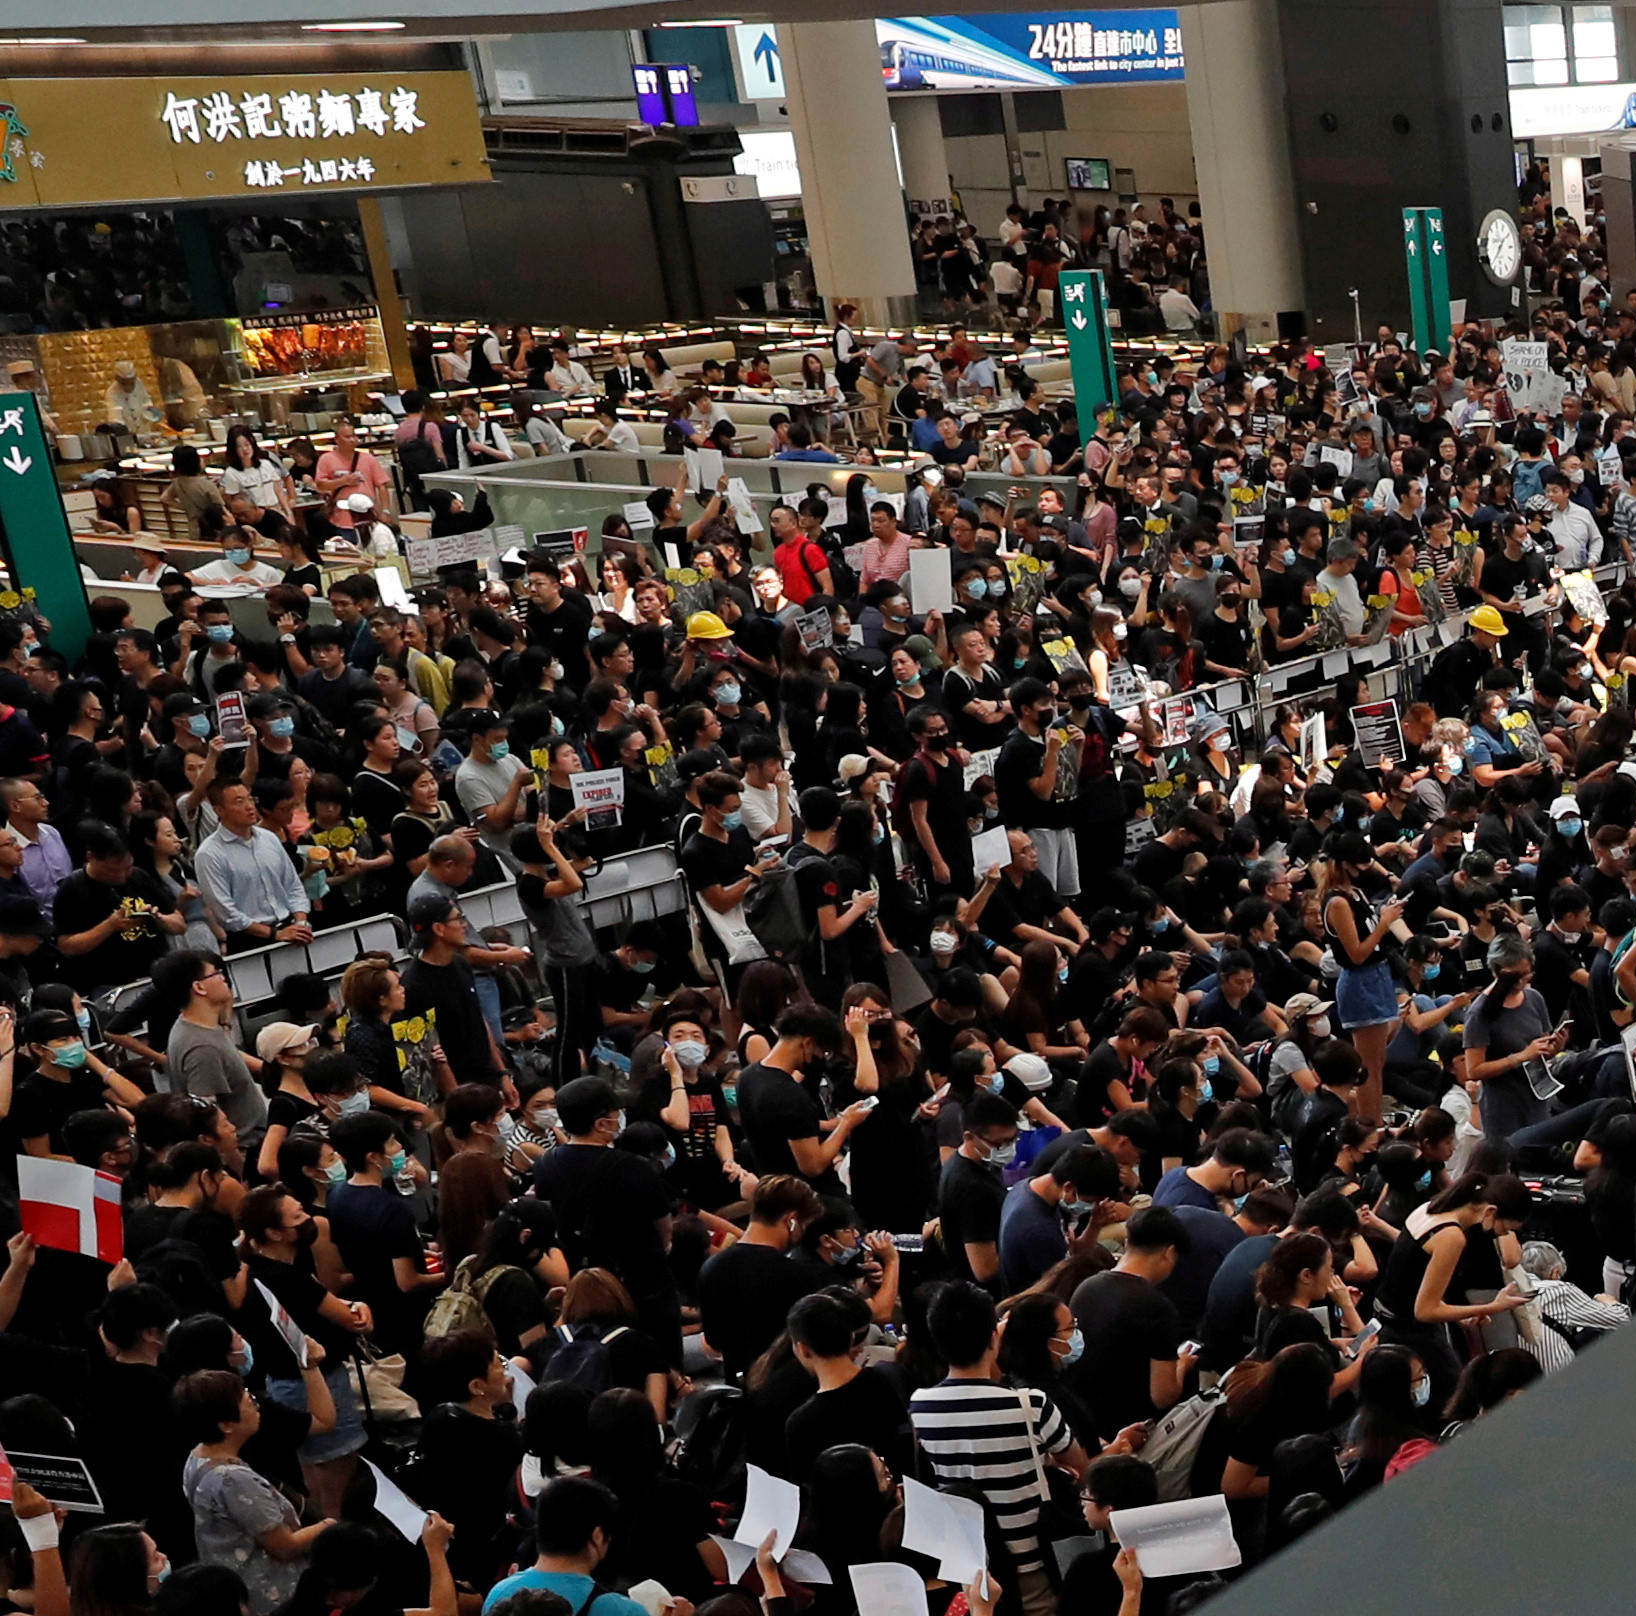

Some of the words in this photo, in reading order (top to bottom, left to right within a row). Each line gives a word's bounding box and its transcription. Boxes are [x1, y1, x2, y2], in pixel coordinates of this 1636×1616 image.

[1052, 60, 1067, 72] The
[1068, 60, 1094, 72] fastest
[1094, 59, 1109, 71] link
[1109, 60, 1118, 70] to
[1119, 59, 1132, 72] city
[1157, 57, 1164, 69] in
[1164, 57, 1179, 70] just
[162, 87, 426, 144] 何洪記粥麵專家
[755, 158, 783, 172] Train
[1534, 345, 1546, 355] ON
